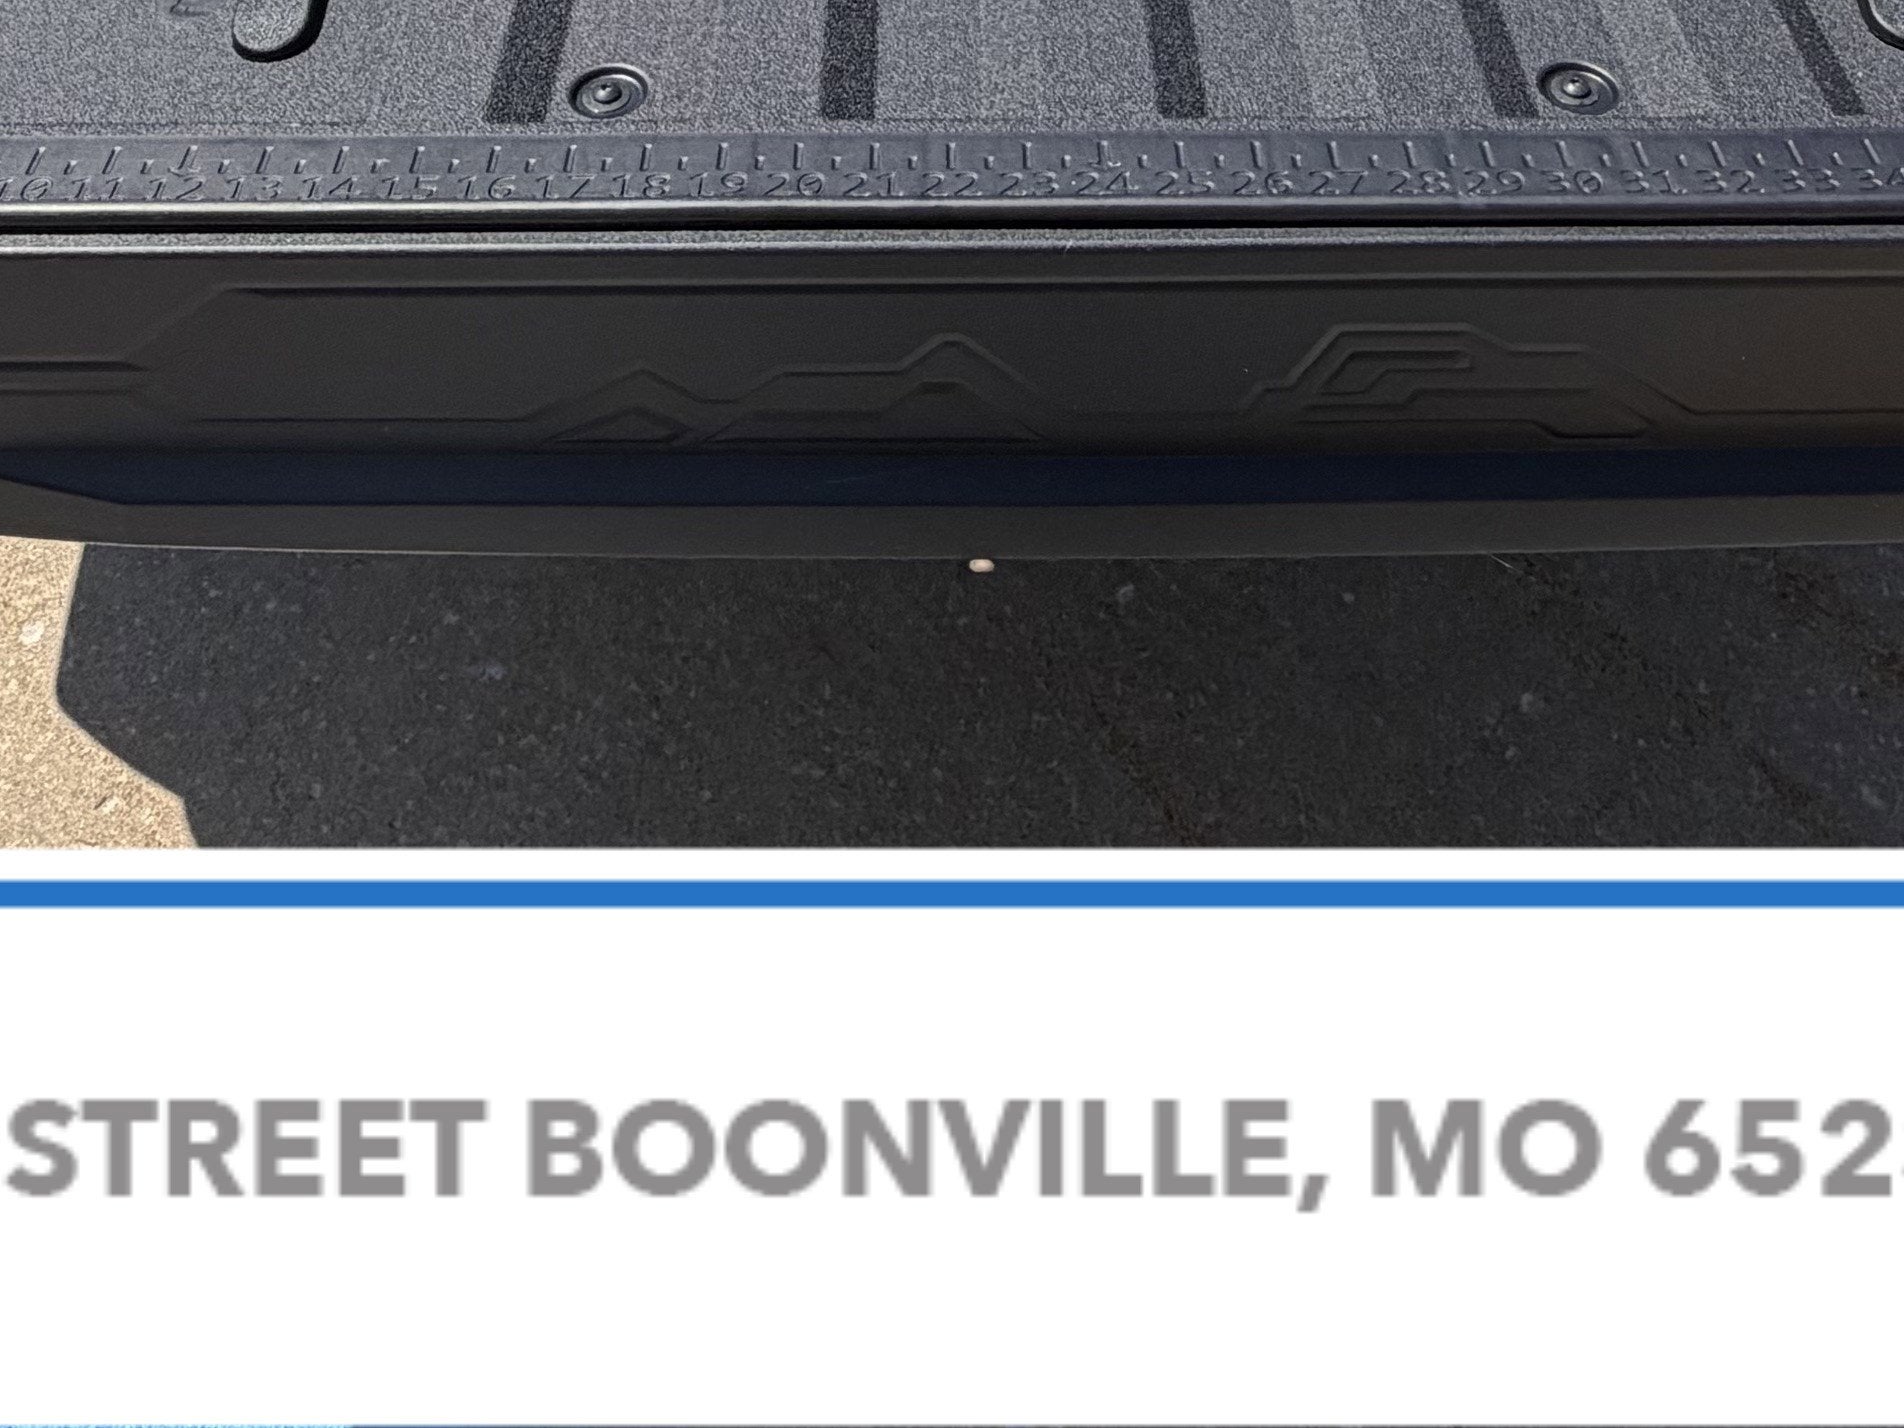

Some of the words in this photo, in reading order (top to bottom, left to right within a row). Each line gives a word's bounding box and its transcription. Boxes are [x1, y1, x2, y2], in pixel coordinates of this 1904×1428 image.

[63, 176, 125, 201] 11
[141, 176, 206, 201] 12
[219, 175, 284, 201] 13
[296, 174, 362, 201] 14
[381, 175, 440, 200] 15
[457, 175, 516, 200] 16
[534, 173, 596, 199] 17
[611, 173, 671, 199] 18
[689, 172, 748, 198] 19
[764, 172, 825, 196] 20
[844, 172, 904, 196] 21
[922, 172, 983, 196] 22
[998, 171, 1060, 196] 23
[1075, 171, 1139, 196] 24
[1155, 170, 1215, 195] 25
[1231, 170, 1294, 195] 26
[1308, 170, 1369, 195] 27
[1386, 169, 1450, 194] 28
[1459, 170, 1526, 195] 29
[1541, 170, 1604, 194] 30
[1619, 170, 1689, 194] 31
[1696, 169, 1765, 193] 32
